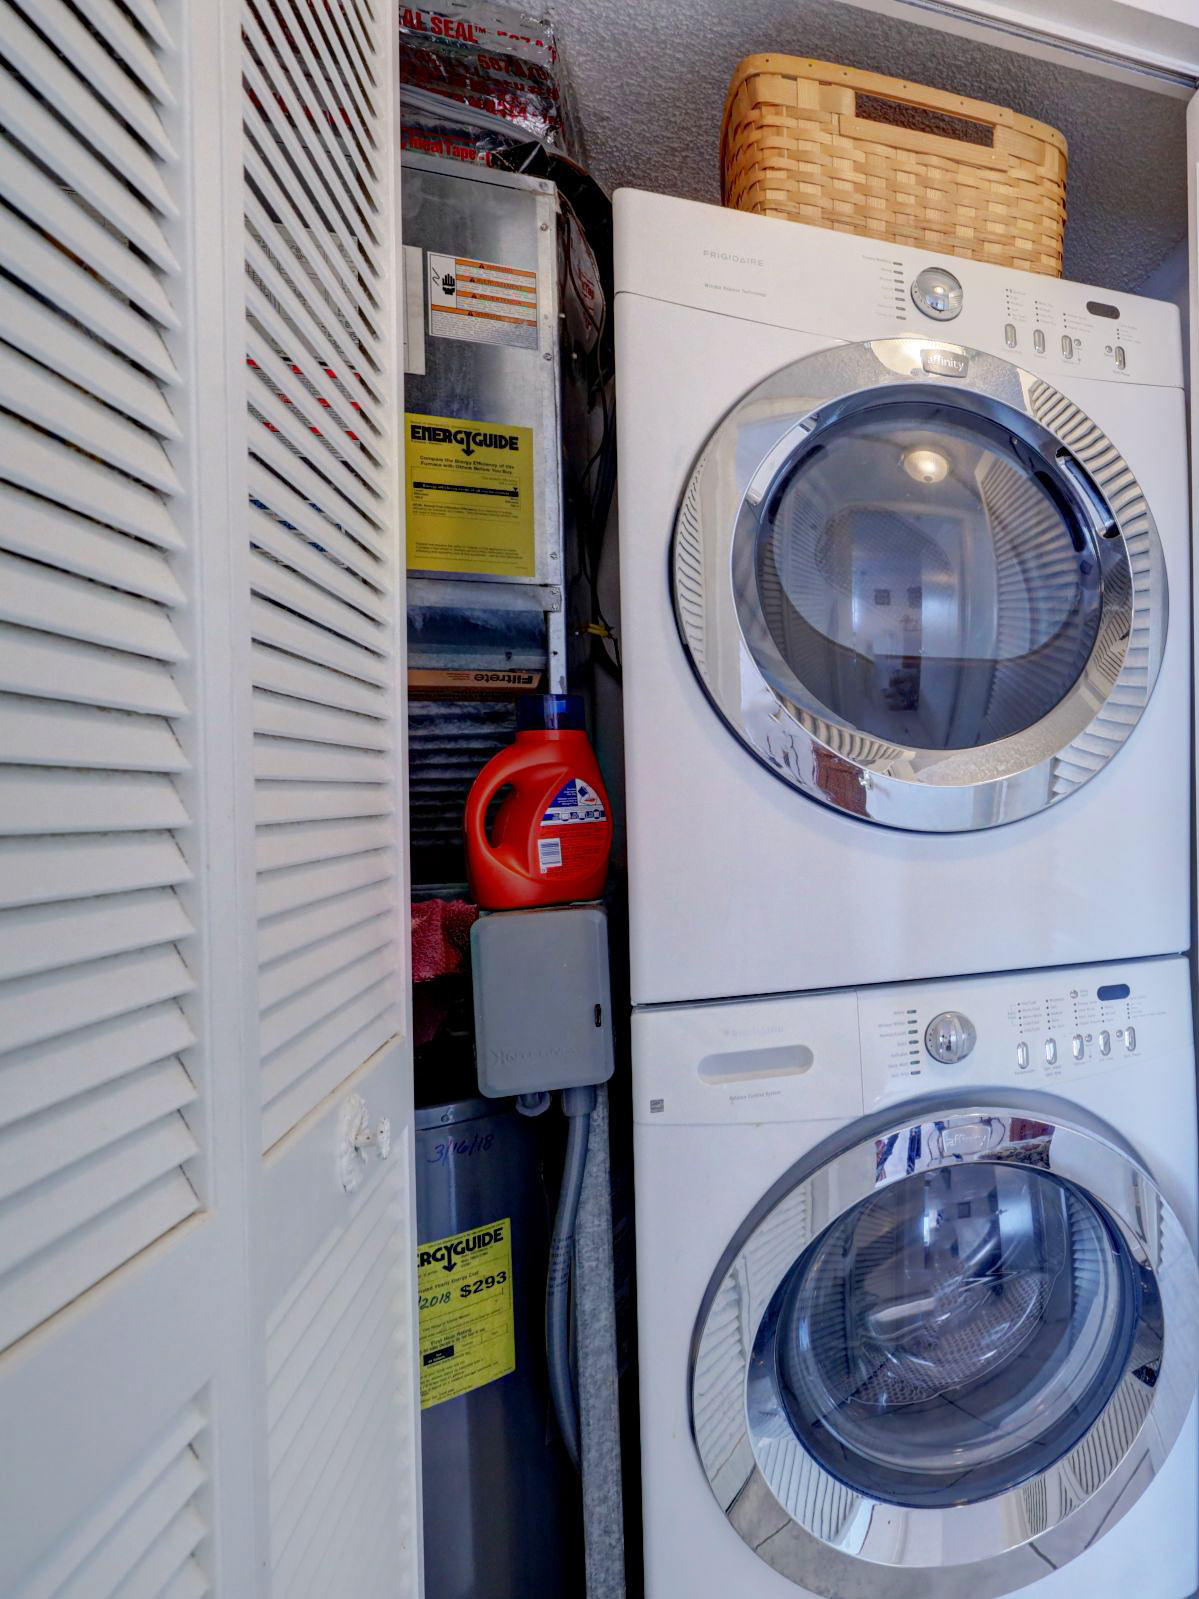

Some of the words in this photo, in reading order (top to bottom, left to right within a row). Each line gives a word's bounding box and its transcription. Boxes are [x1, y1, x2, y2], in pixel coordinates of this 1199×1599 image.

[399, 7, 427, 32] AL
[703, 249, 765, 267] FRIGIDAIRE
[928, 354, 965, 372] affinity
[474, 673, 534, 685] Filtrete
[417, 1227, 504, 1269] RGYGUIDE
[459, 1271, 507, 1298] $293
